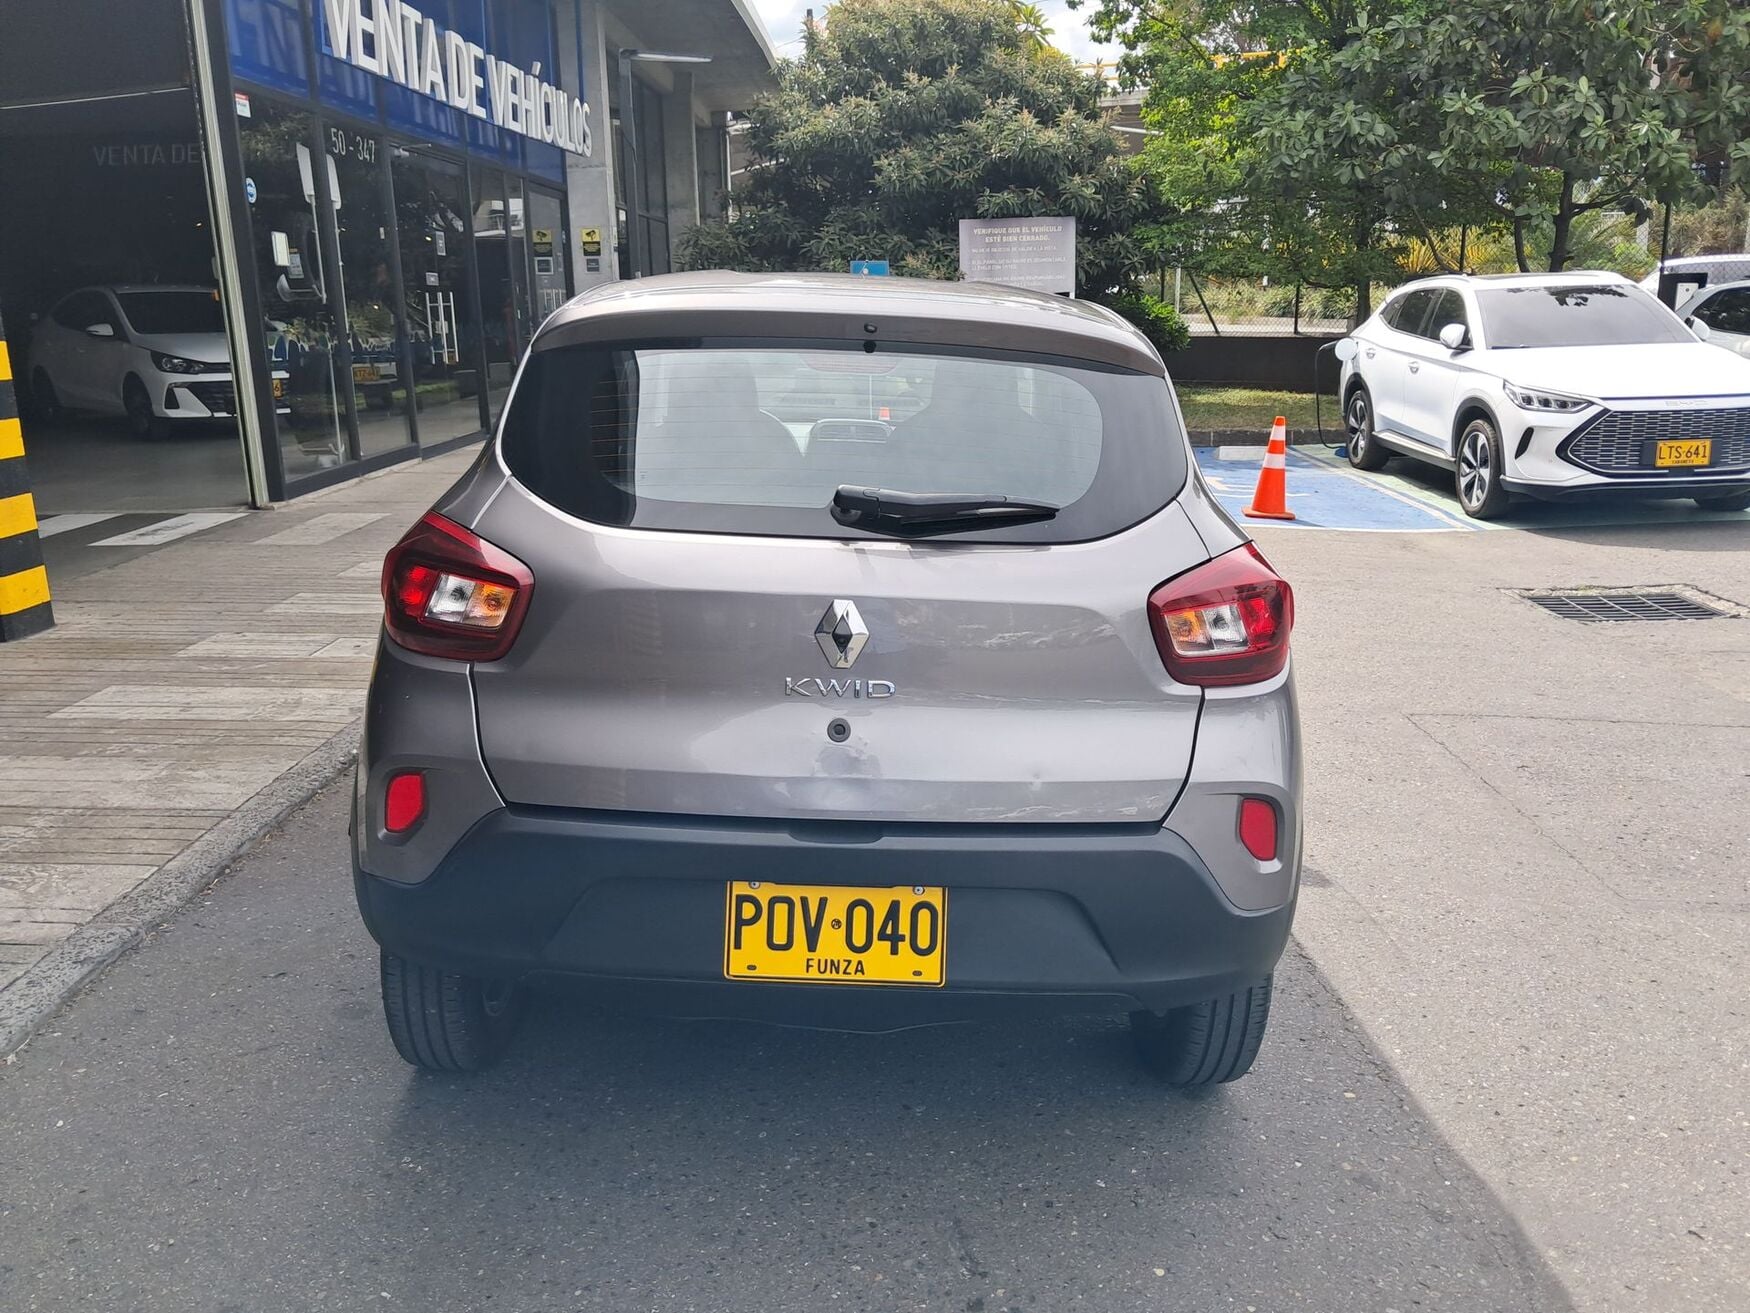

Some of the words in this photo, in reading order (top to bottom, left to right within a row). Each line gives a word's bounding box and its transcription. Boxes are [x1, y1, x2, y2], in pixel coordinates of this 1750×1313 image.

[323, 0, 447, 102] VENTA
[445, 30, 487, 119] DE
[485, 54, 592, 157] VEHÍCULOS
[93, 143, 166, 167] VENTA
[171, 142, 201, 164] DE
[330, 127, 346, 156] 50
[355, 136, 375, 163] 347
[784, 677, 896, 699] KWID
[805, 957, 865, 976] FUNZA
